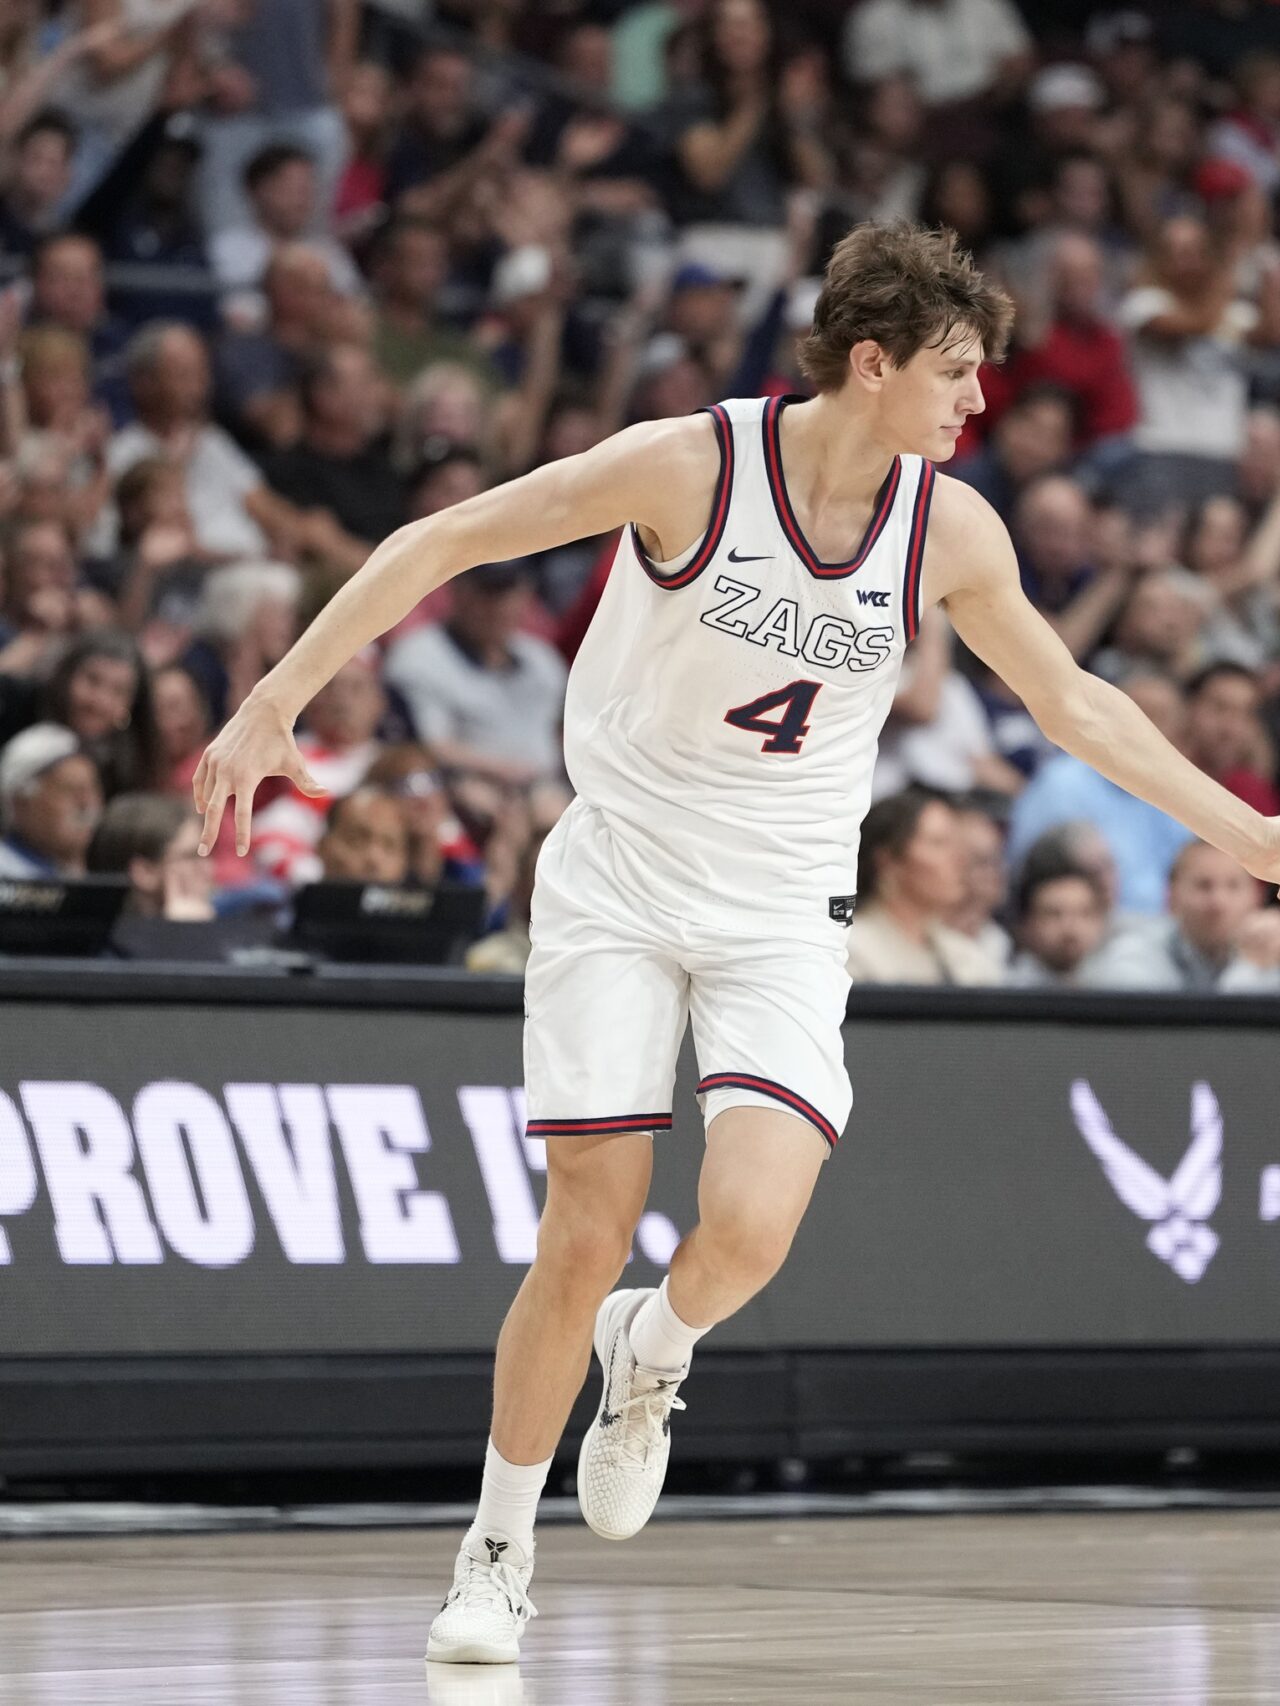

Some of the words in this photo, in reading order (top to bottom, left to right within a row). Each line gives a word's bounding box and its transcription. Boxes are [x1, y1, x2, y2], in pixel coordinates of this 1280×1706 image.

[700, 575, 894, 672] ZAGS
[856, 590, 891, 607] WCC
[723, 679, 823, 754] 4
